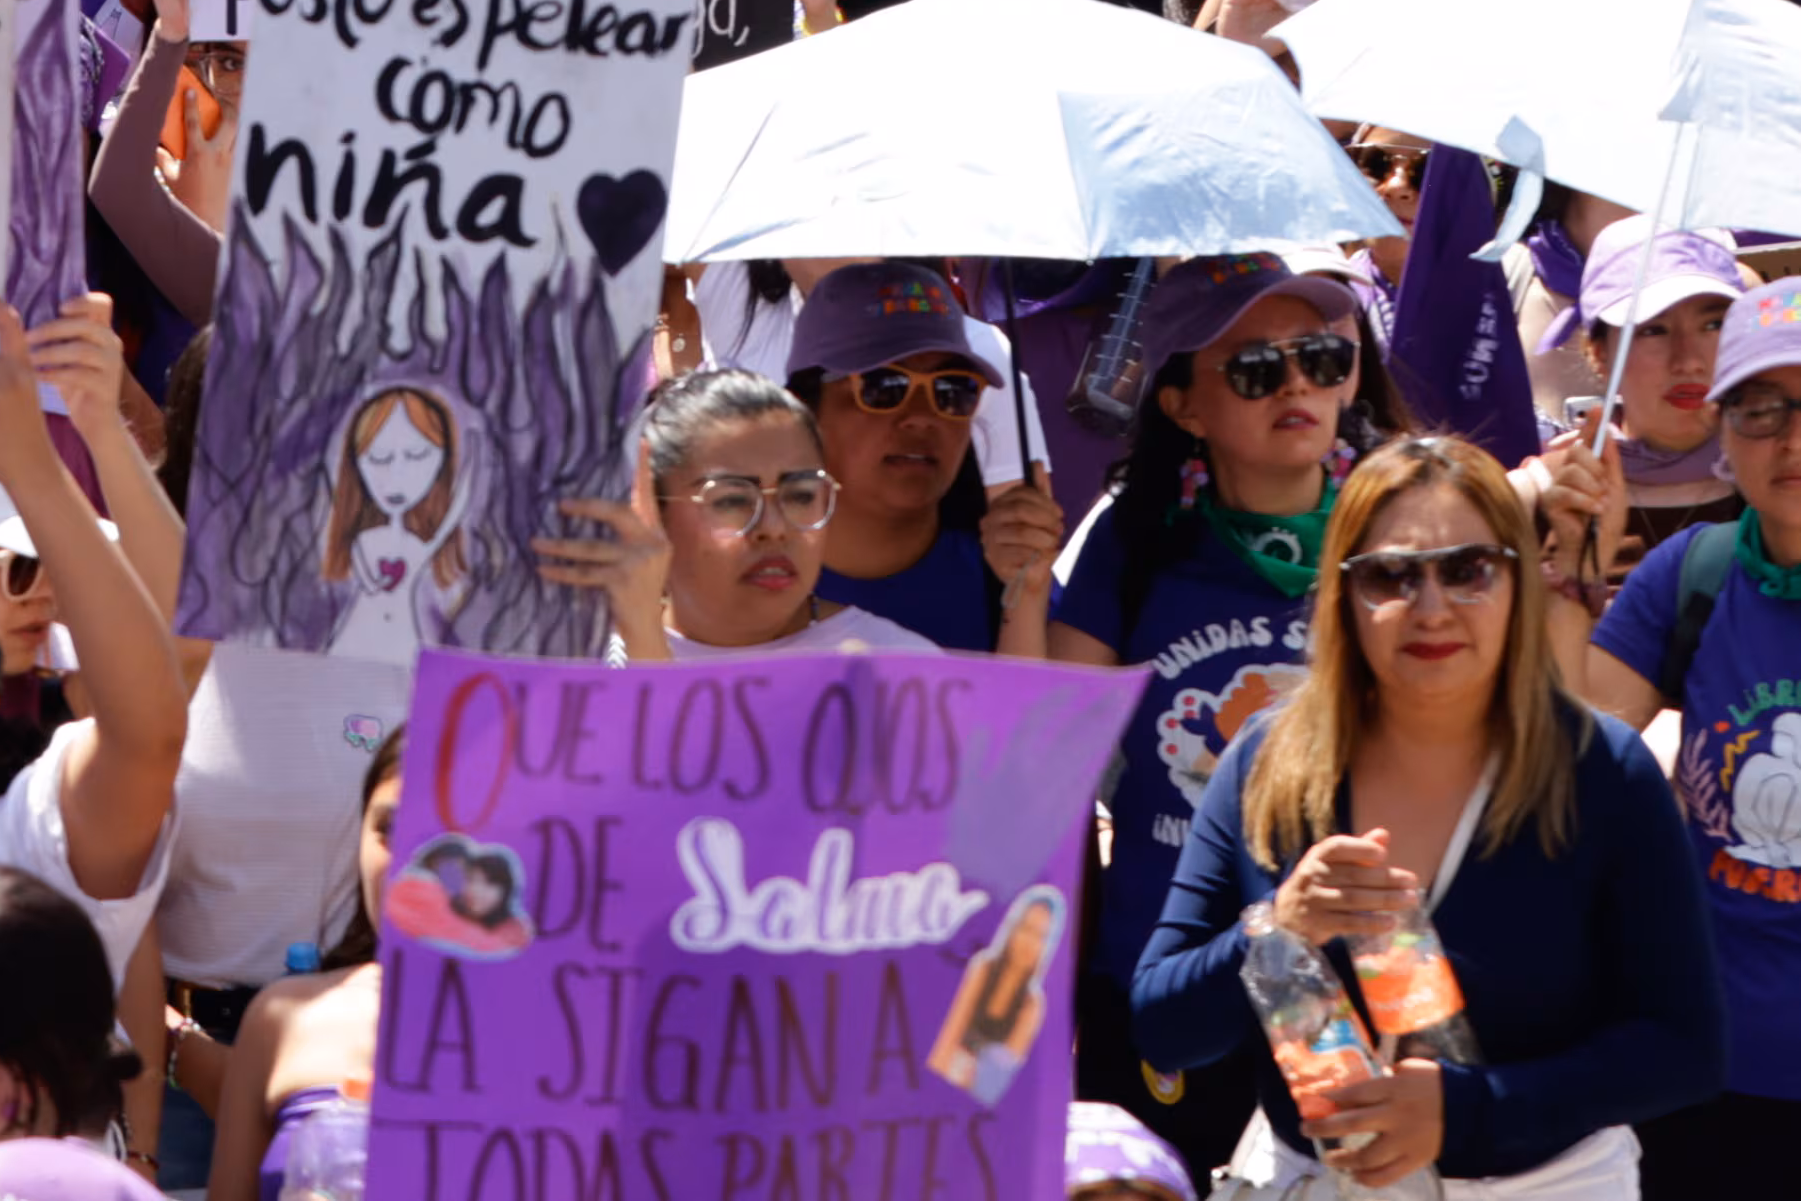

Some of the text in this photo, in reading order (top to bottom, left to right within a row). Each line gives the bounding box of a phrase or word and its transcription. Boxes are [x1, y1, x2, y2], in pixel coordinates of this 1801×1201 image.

[634, 676, 771, 800] LOS
[531, 815, 625, 953] DE
[539, 960, 842, 1113] SIGAN
